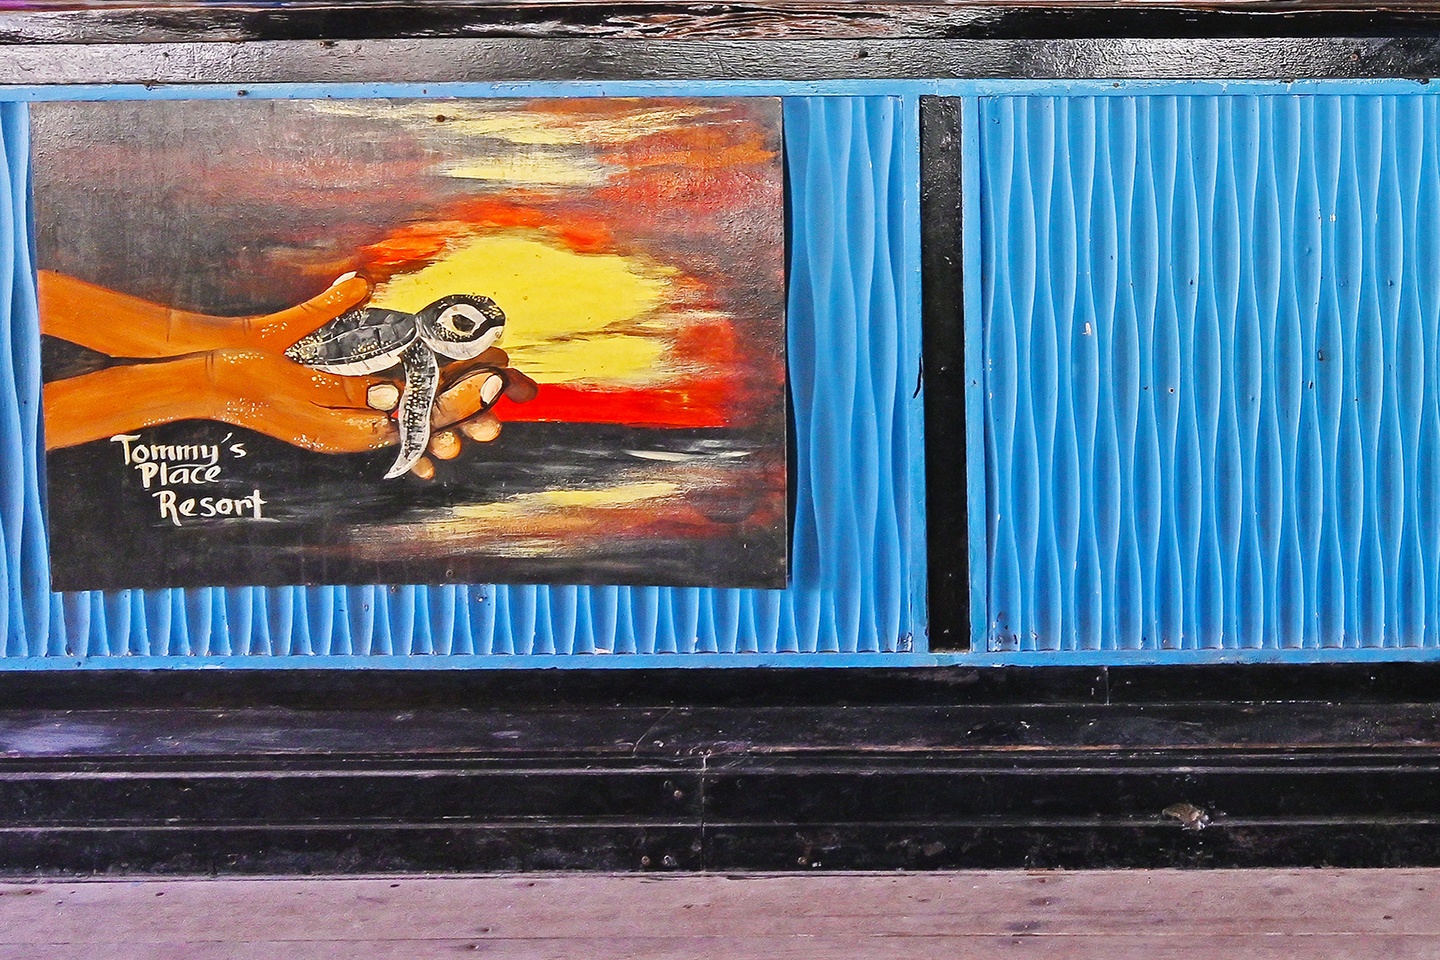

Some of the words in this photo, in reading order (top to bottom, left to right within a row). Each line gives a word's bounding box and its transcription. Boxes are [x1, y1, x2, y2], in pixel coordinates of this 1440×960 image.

[110, 432, 247, 468] Tommy's
[135, 461, 222, 489] Place
[152, 489, 267, 527] Resort
